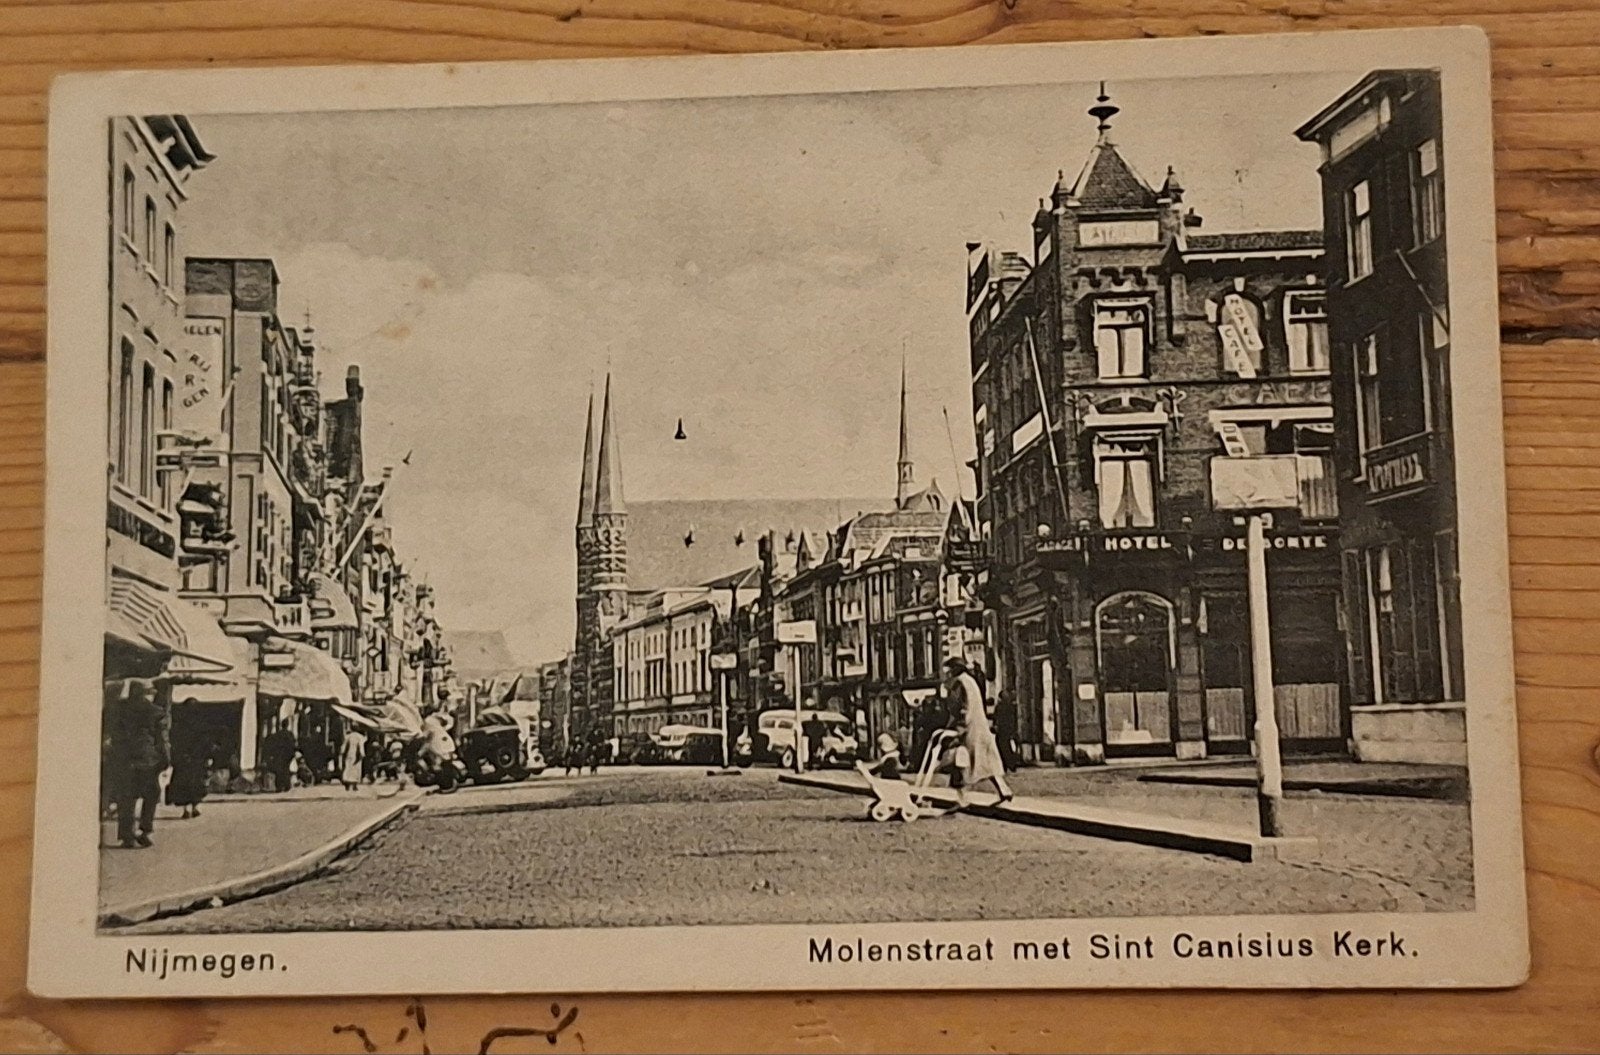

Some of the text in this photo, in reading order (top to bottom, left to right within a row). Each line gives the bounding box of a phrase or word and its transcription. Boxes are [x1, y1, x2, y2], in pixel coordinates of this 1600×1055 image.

[1105, 536, 1172, 550] HOTEL
[809, 930, 1419, 963] Molenstraat met Sint Canisius Kerk.
[126, 948, 288, 979] Nijmegen.
